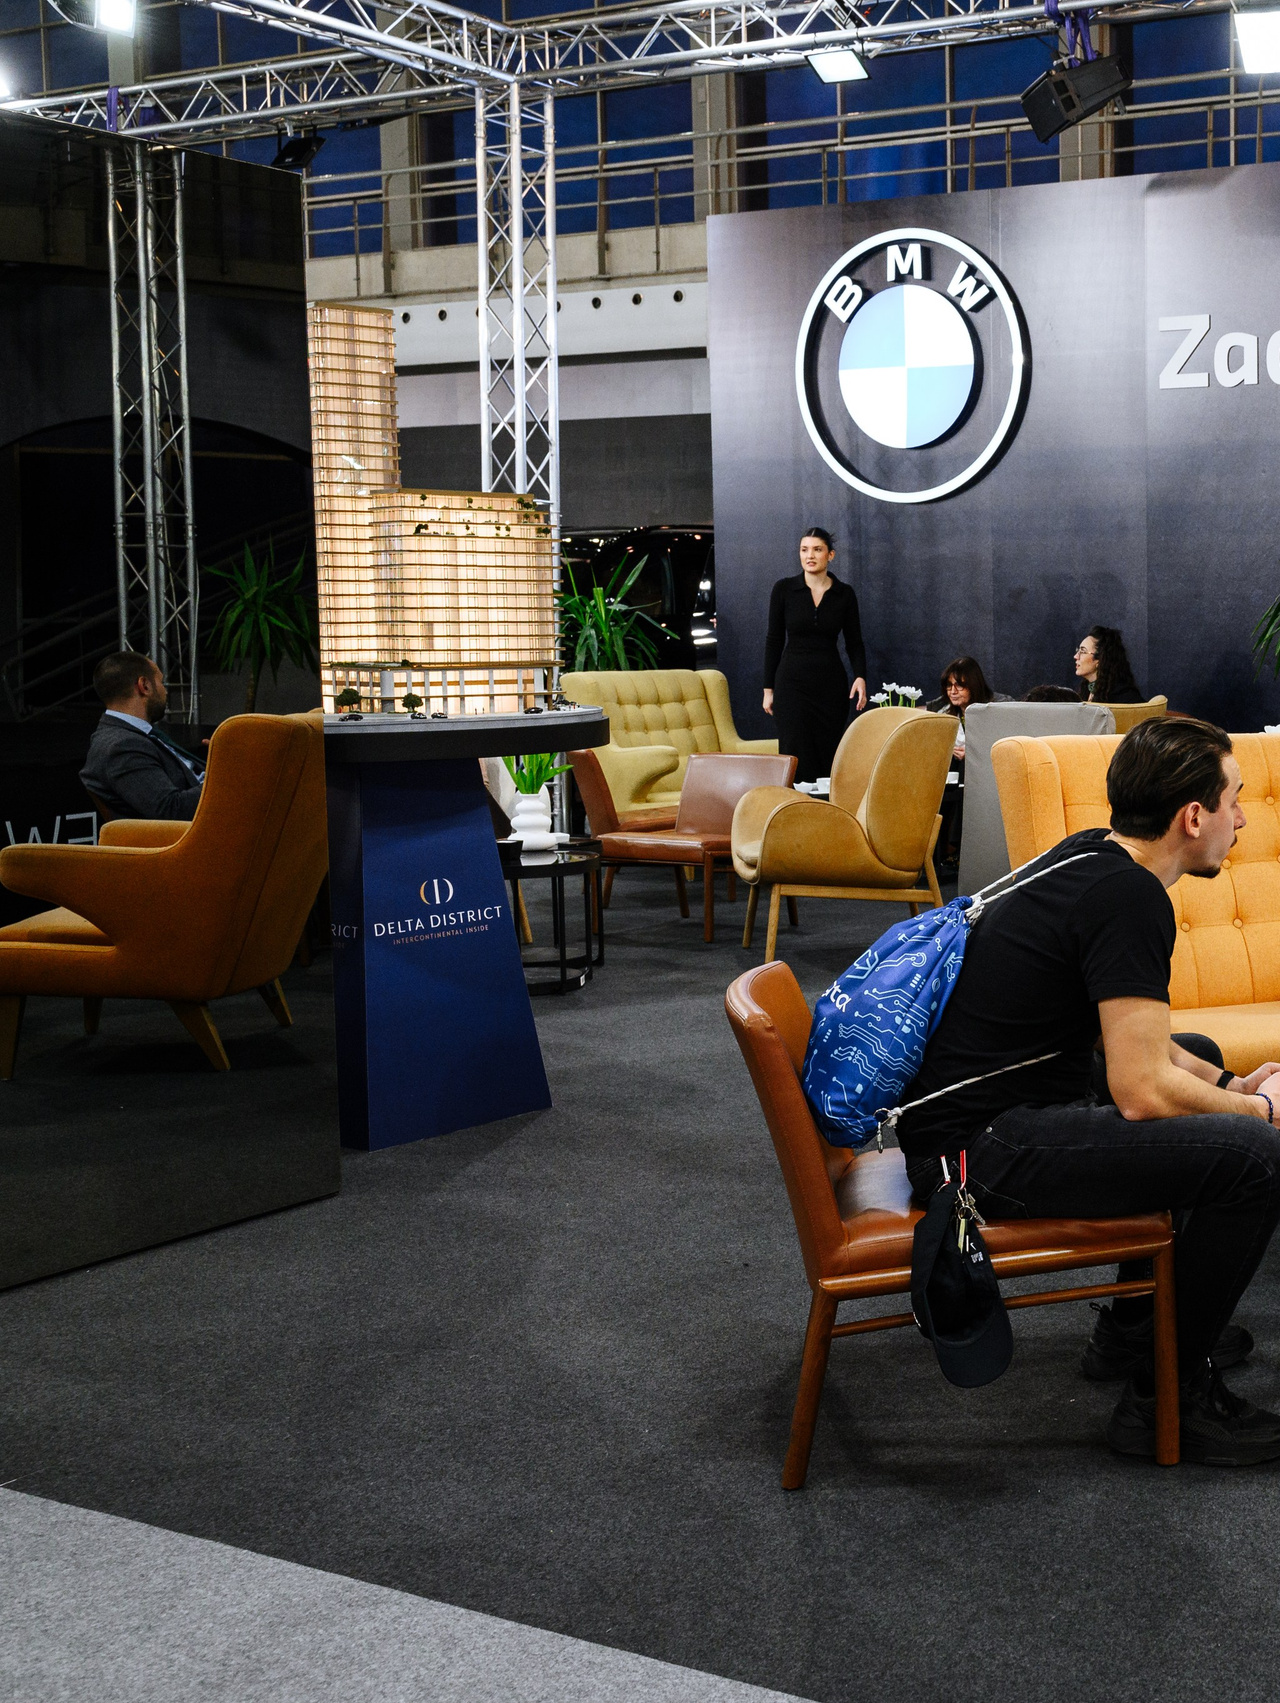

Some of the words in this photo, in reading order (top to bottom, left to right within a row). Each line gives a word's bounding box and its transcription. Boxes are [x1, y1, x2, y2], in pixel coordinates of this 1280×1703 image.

[824, 243, 993, 324] BMW
[373, 917, 425, 937] DELTA
[429, 905, 502, 929] DISTRICT
[393, 928, 463, 945] INTERCONTINENTAL
[465, 924, 489, 934] INSIDE
